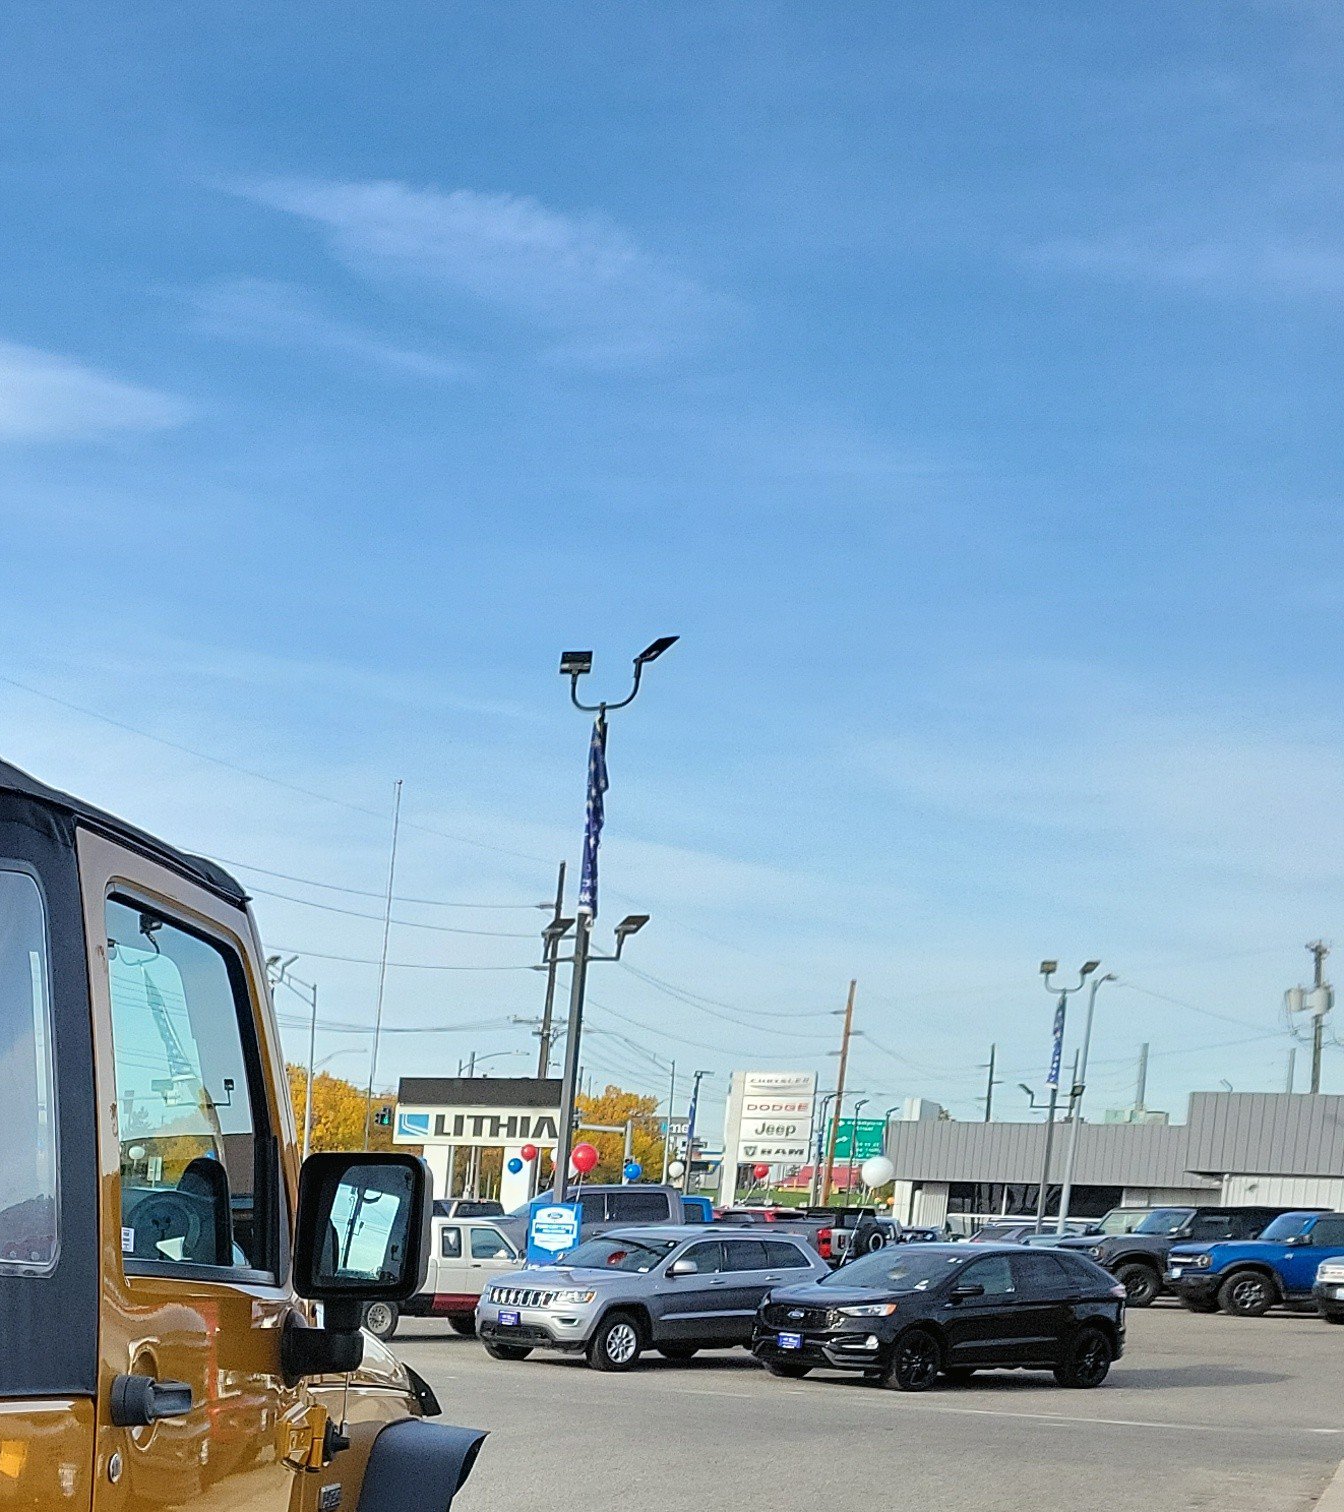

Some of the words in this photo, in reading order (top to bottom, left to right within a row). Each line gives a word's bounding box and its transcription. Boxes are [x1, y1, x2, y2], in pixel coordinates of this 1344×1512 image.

[746, 1102, 809, 1112] DODGE
[433, 1113, 559, 1139] LITHIA
[754, 1121, 797, 1137] Jeep
[759, 1148, 805, 1156] RAM
